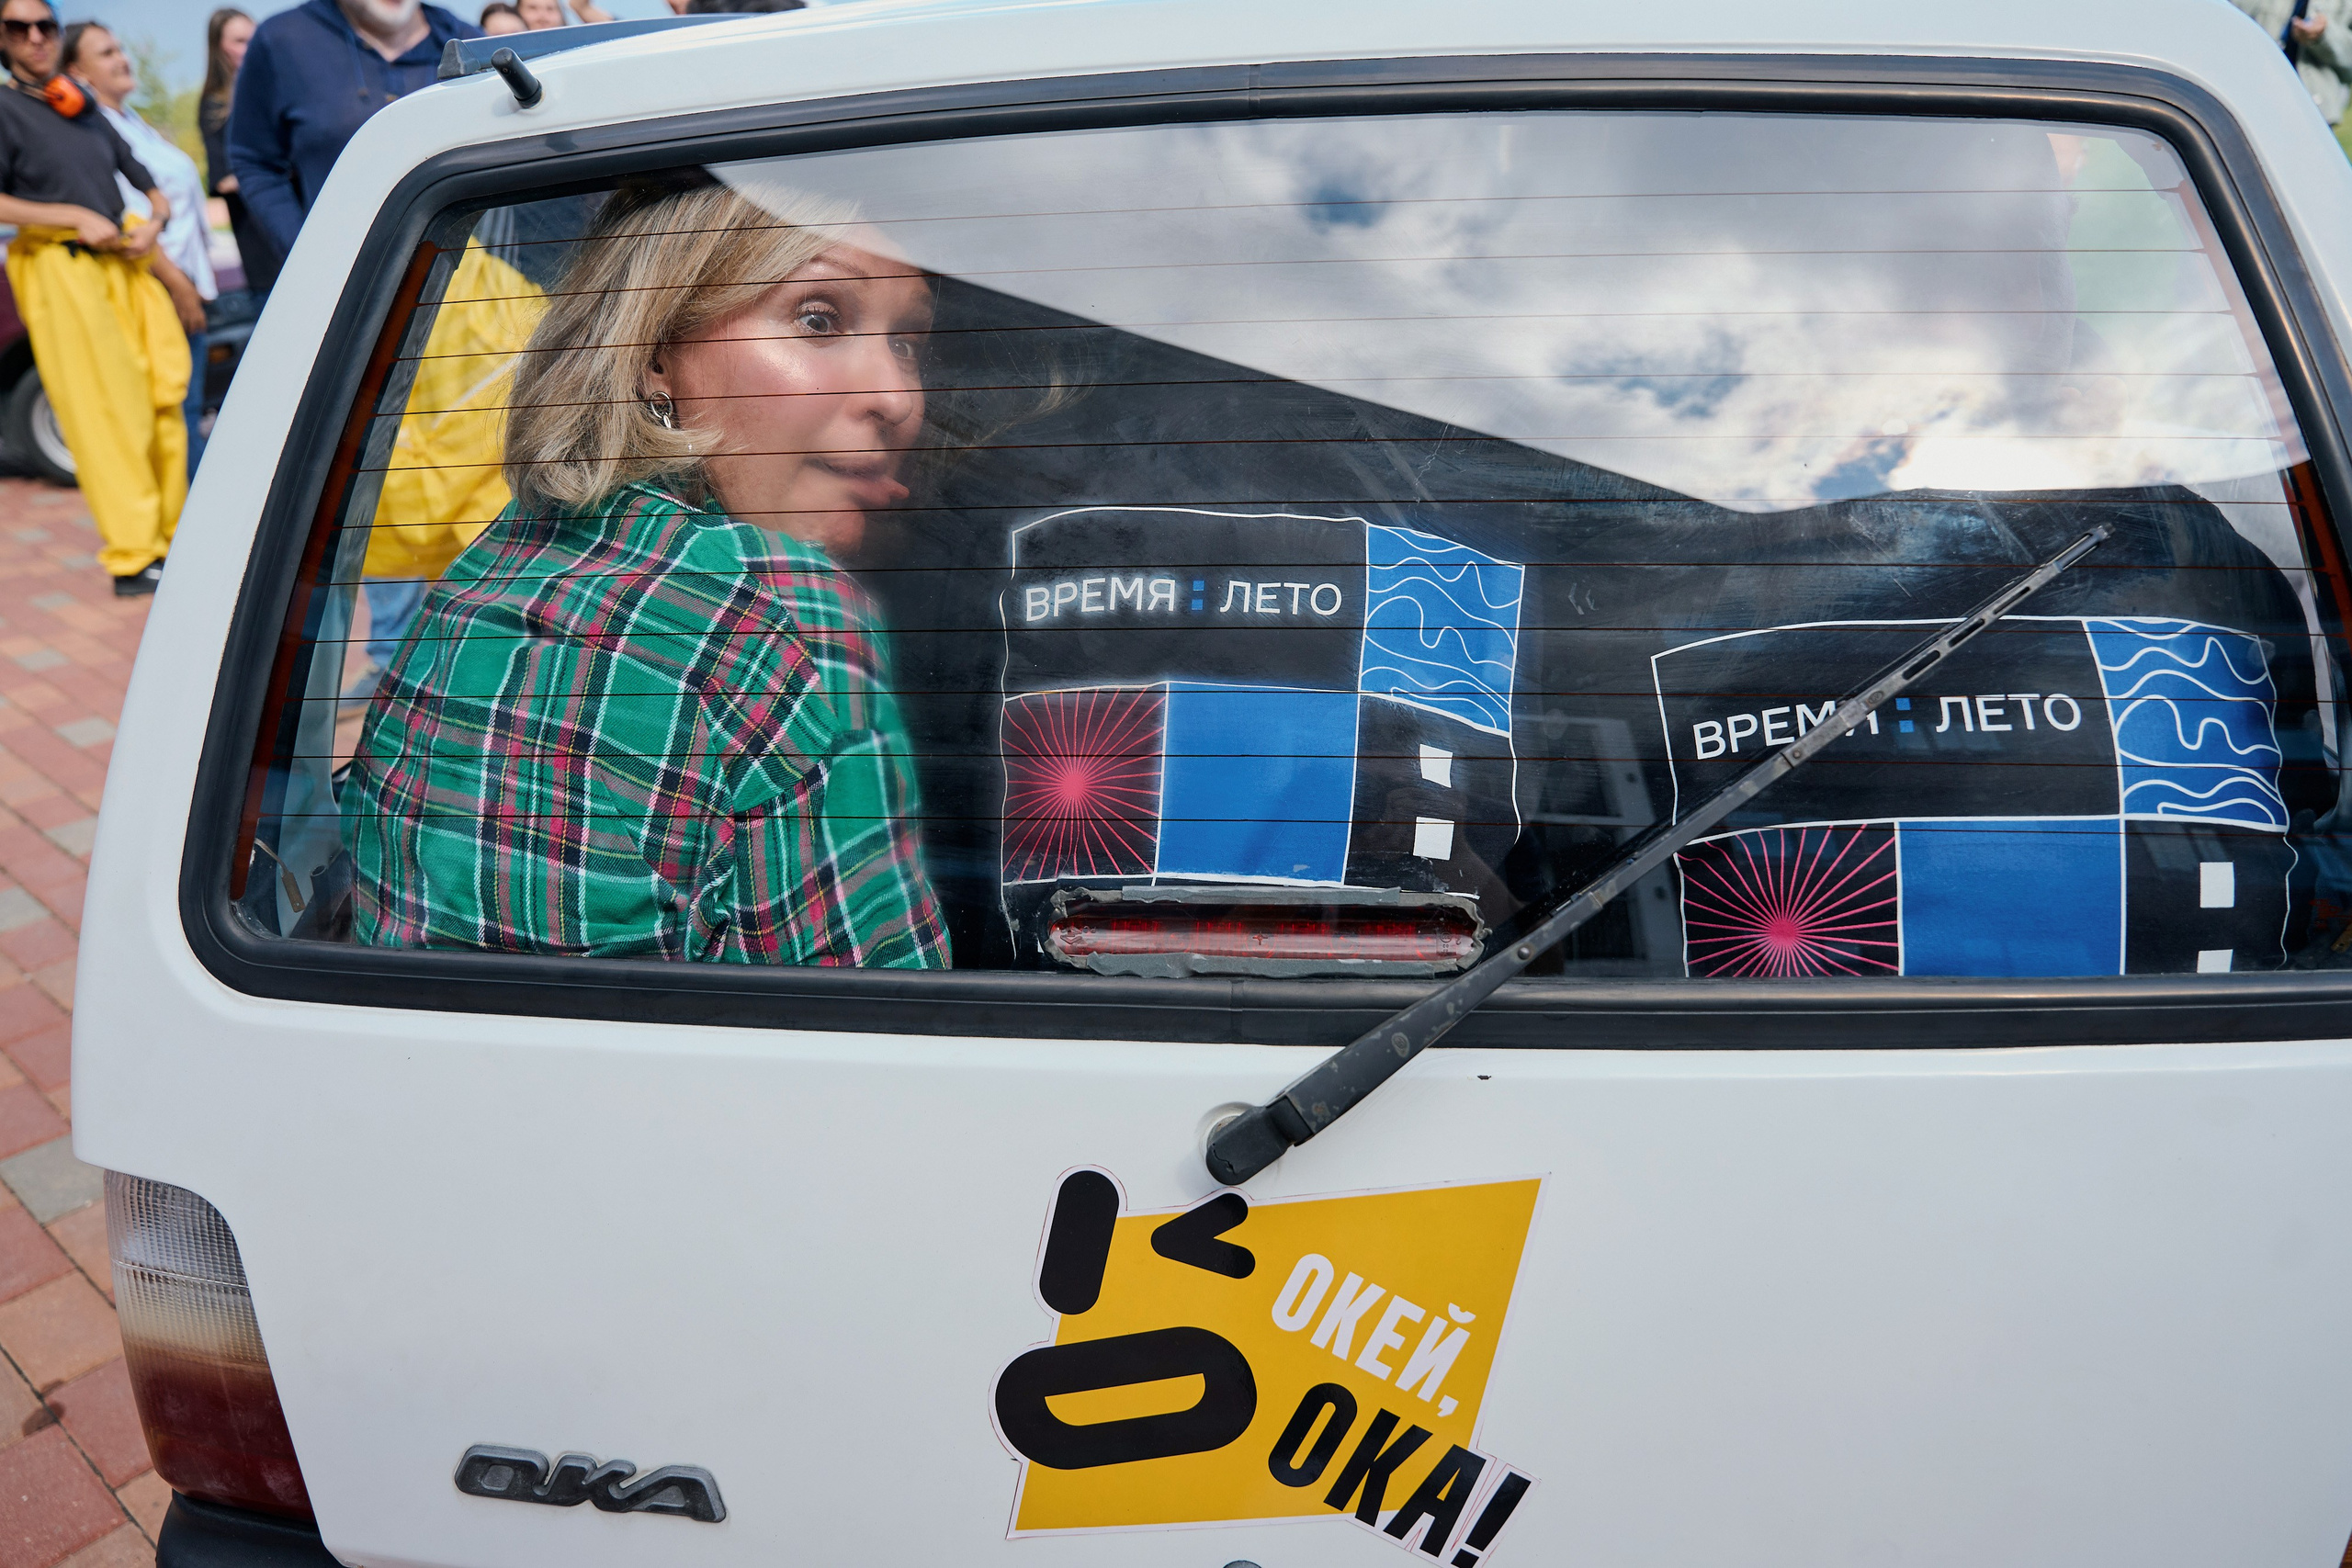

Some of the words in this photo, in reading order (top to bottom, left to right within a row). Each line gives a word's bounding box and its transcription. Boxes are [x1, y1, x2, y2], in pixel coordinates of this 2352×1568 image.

[1025, 577, 1176, 622] ВРЕМЯ
[1219, 580, 1342, 615] ЛЕТО
[1692, 700, 1880, 761] ВРЕМ
[1935, 693, 2082, 733] ЛЕТО
[1272, 1253, 1476, 1417] ОКЕЙ,
[1268, 1382, 1532, 1568] ОКА!
